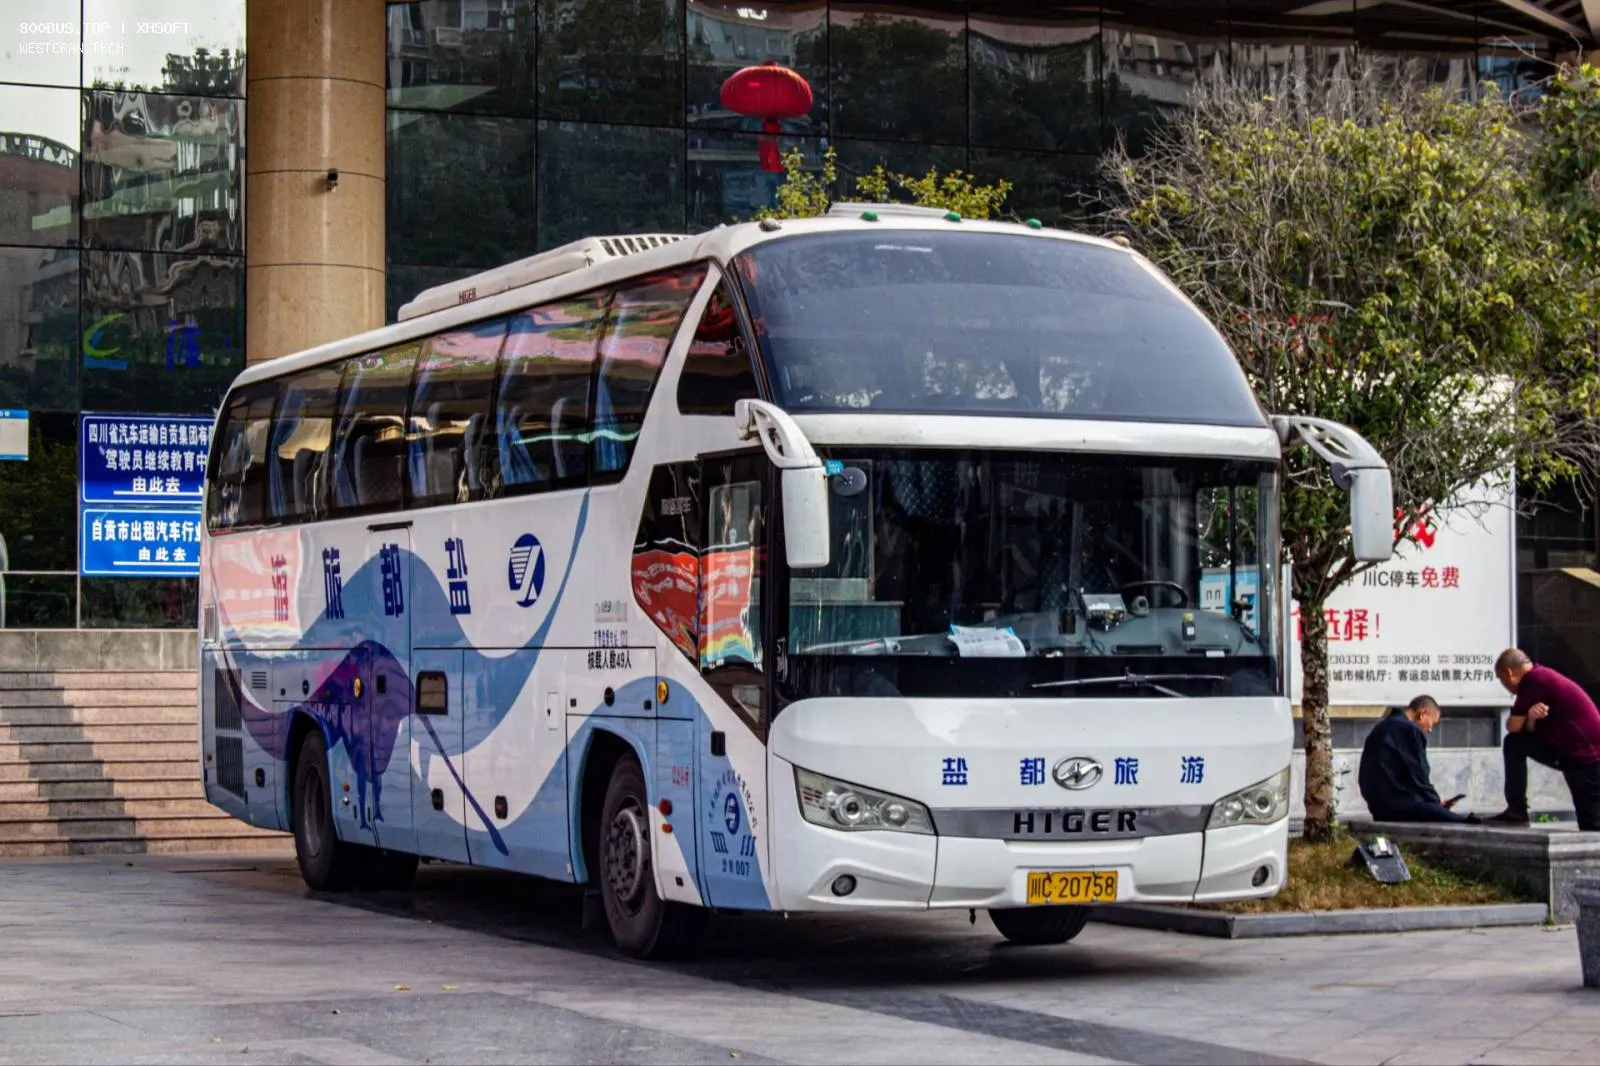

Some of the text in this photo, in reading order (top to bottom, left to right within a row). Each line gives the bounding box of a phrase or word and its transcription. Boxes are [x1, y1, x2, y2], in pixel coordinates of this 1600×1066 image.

[132, 476, 180, 493] 由此去
[138, 547, 187, 561] 由此去
[1013, 811, 1137, 834] HIGER
